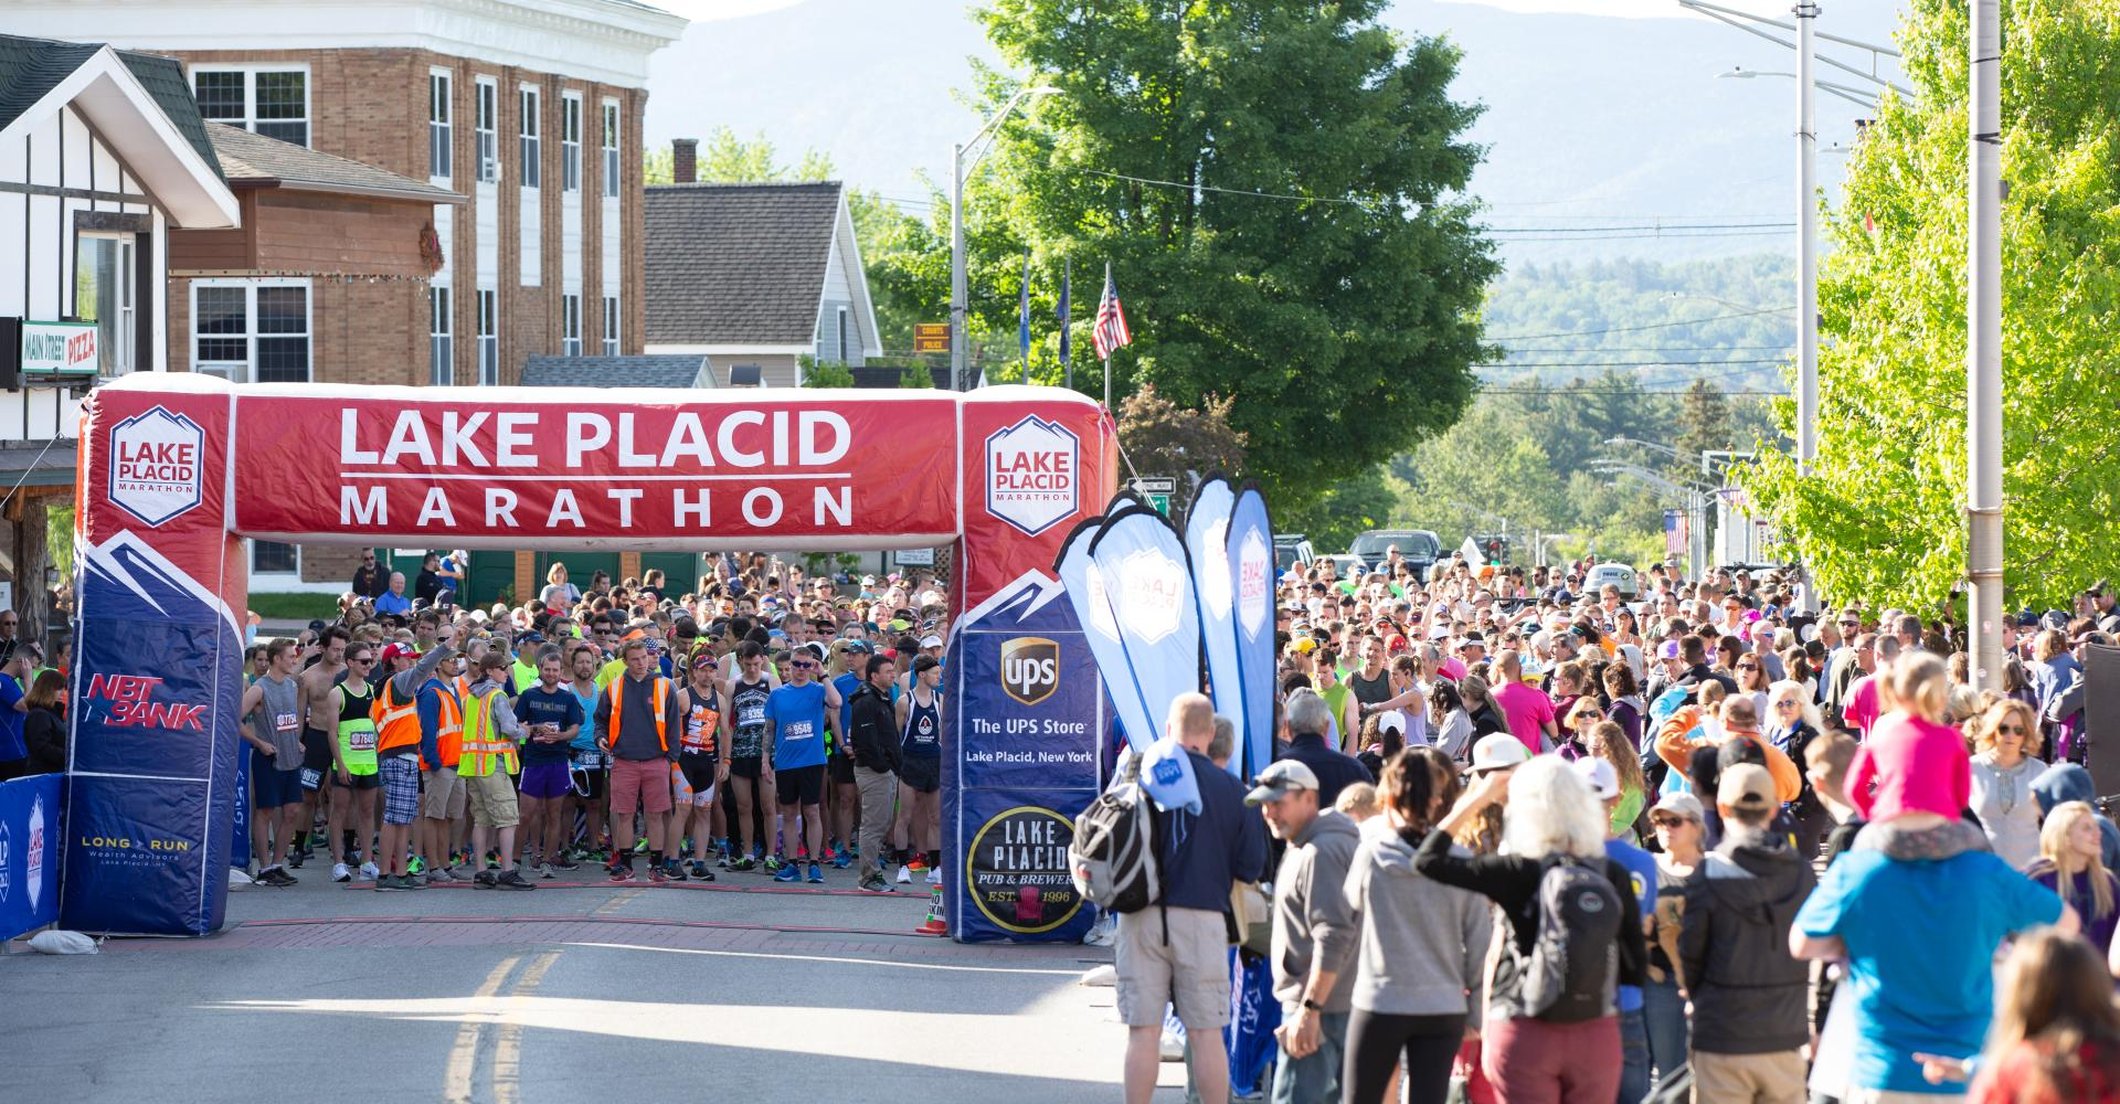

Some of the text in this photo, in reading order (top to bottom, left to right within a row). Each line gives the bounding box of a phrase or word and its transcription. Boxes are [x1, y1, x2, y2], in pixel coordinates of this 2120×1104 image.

[25, 329, 95, 365] MAIN STREET PIZZA
[341, 408, 851, 468] LAKE PLACID
[119, 441, 194, 465] LAKE
[996, 451, 1070, 473] LAKE
[119, 464, 193, 481] PLACID
[996, 474, 1070, 490] PLACID
[119, 483, 193, 493] MARATHON
[341, 486, 852, 528] MARATHON
[88, 673, 164, 700] NBT
[1005, 657, 1055, 695] ups
[104, 700, 207, 731] BANK
[972, 718, 1085, 734] The UPS Store
[966, 751, 1092, 764] Lake Placid, New York
[1005, 820, 1056, 844] LAKE
[82, 836, 188, 851] LONG RUN
[89, 851, 179, 861] Wealth Advisors
[993, 846, 1066, 870] PLACID
[978, 874, 1073, 884] PUB & BREWER
[988, 891, 1070, 902] EST. 1996
